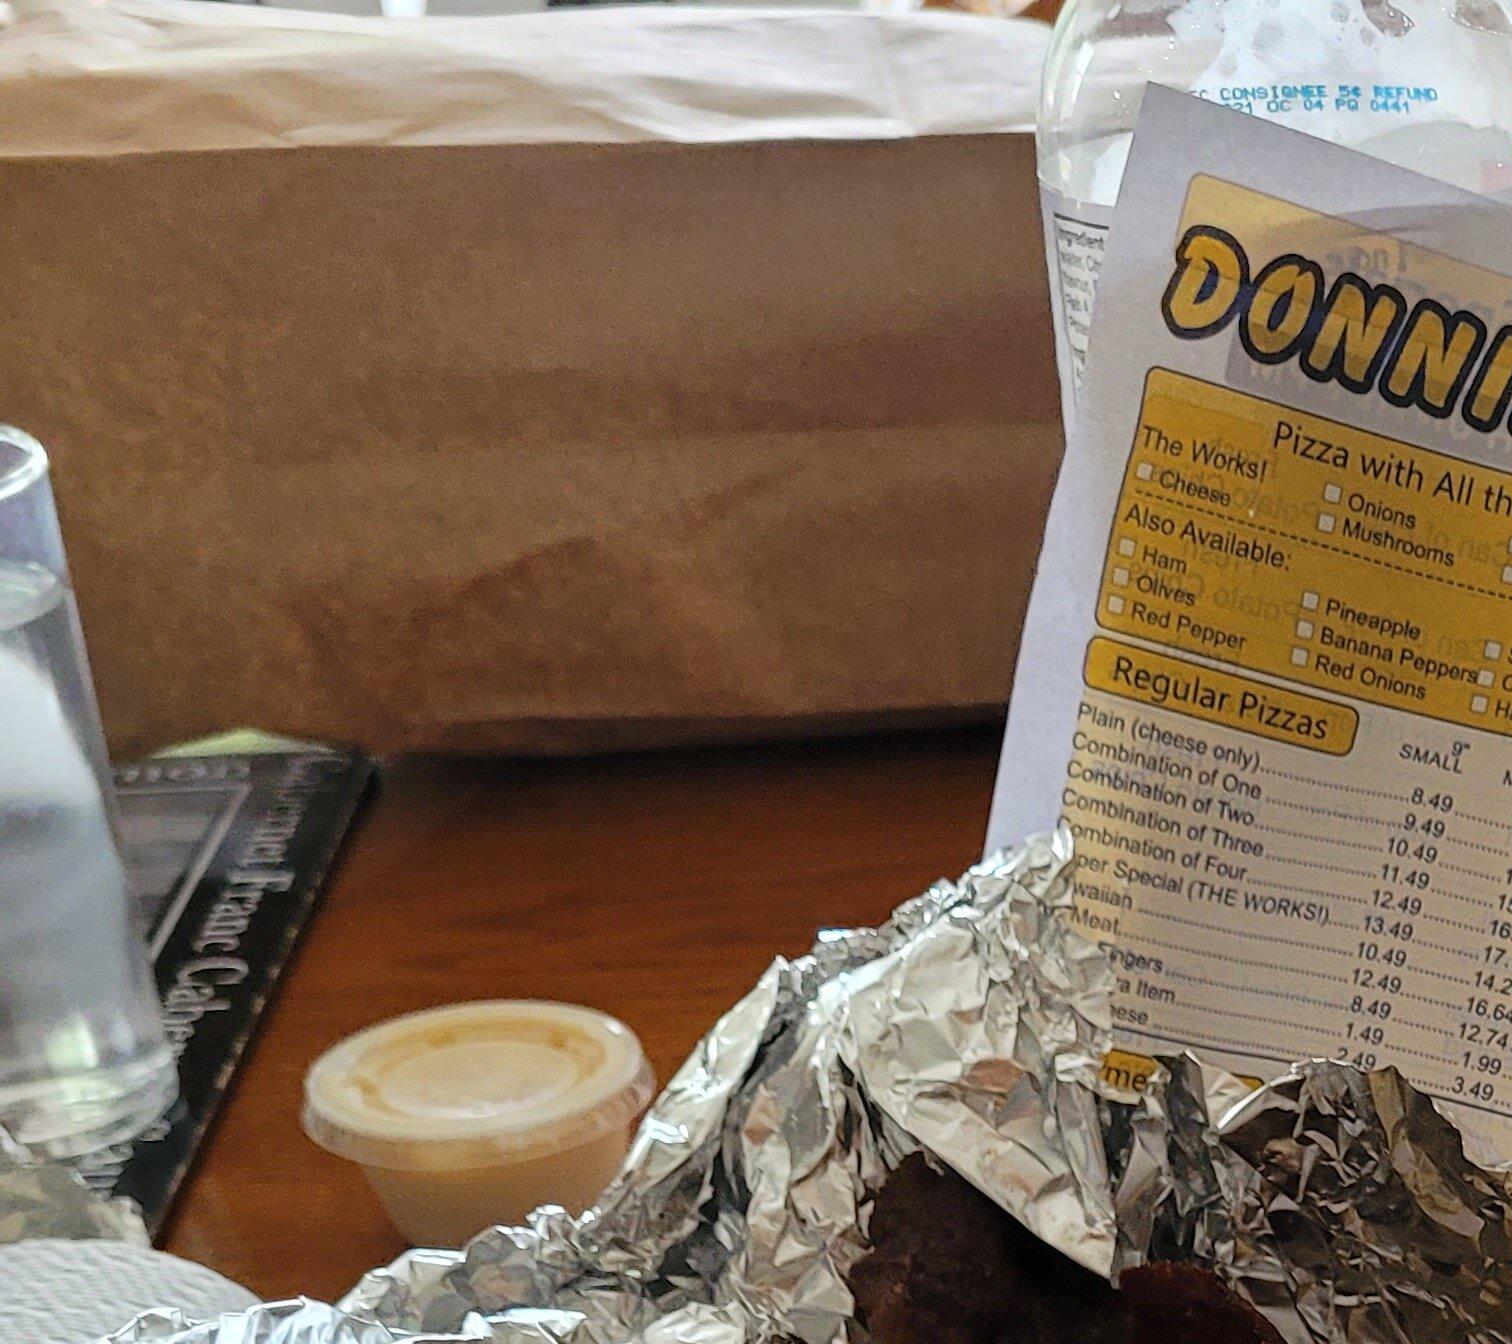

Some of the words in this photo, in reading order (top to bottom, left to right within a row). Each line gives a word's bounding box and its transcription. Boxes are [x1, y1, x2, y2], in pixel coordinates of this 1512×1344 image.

[1373, 86, 1438, 102] REFUND
[1142, 425, 1184, 457] The
[1191, 440, 1268, 483] Works!
[1273, 420, 1350, 469] Pizza
[1361, 453, 1423, 492] with
[1432, 471, 1475, 506] All
[1159, 469, 1232, 507] Cheese
[1348, 493, 1417, 530] Onions
[1124, 503, 1175, 536] Also
[1179, 520, 1292, 572] Available:
[1142, 546, 1187, 575] Ham
[1342, 517, 1456, 567] Mushrooms
[1136, 575, 1197, 607] Olives
[1325, 597, 1421, 641] Pineapple
[1320, 626, 1393, 663] Banana
[1399, 648, 1480, 685] Peppers
[1112, 655, 1231, 712] Regular
[1240, 691, 1328, 739] Pizzas
[1077, 701, 1125, 735] Plain
[1131, 717, 1207, 756] (cheese
[1213, 744, 1262, 774] only)
[1398, 743, 1464, 775] SMALL
[1071, 732, 1192, 779] Combination
[1221, 774, 1262, 800] One
[1410, 788, 1454, 813] 8.49
[1113, 863, 1182, 895] Special
[1187, 880, 1236, 909] (THE
[1243, 891, 1330, 926] WORKS!)
[1451, 1075, 1495, 1100] 3.49
